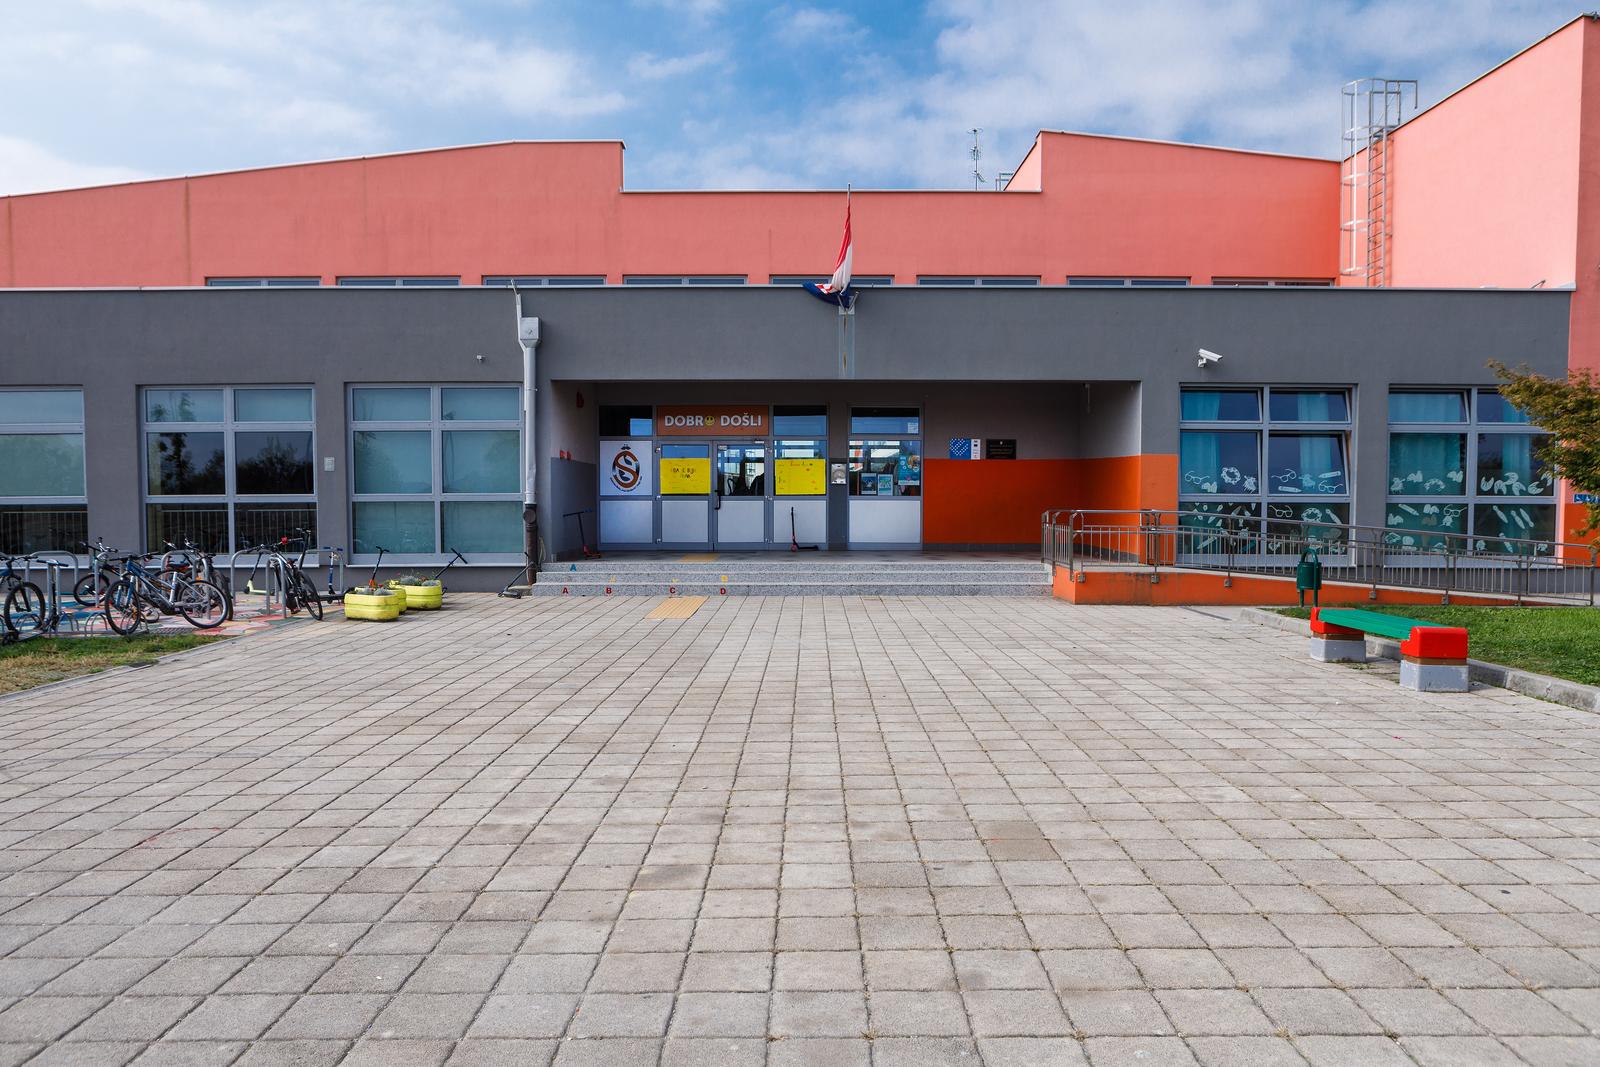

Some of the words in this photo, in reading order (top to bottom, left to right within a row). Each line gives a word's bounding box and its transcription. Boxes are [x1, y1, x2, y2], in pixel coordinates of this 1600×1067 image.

[720, 412, 762, 426] DOŠLI
[570, 563, 577, 572] A
[720, 587, 726, 595] D
